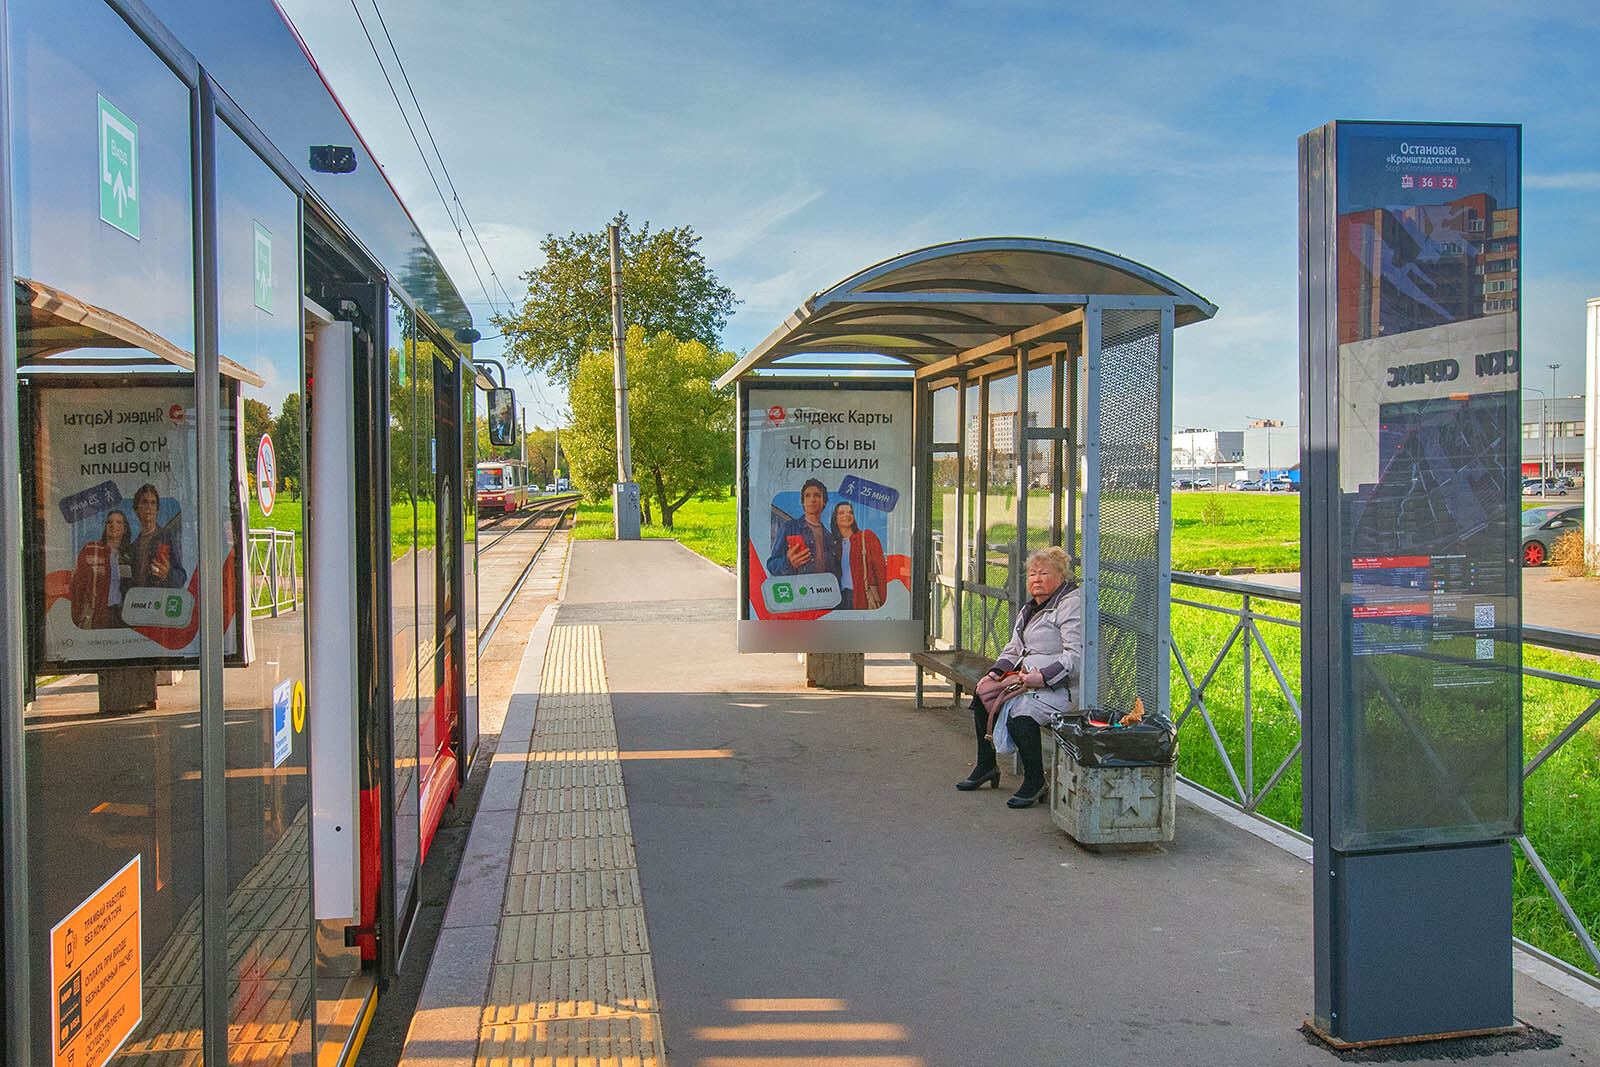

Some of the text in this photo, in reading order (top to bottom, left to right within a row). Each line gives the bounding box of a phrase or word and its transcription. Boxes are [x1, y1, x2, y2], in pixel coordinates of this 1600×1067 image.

[1400, 143, 1457, 155] Остановка
[1386, 154, 1453, 165] «Кронштадтская
[1421, 178, 1454, 188] 36 52
[793, 409, 893, 426] Яндекс Карты
[790, 435, 876, 451] Что бы вы
[786, 458, 879, 472] ни решили
[860, 486, 890, 502] 25 мин
[809, 586, 815, 595] 1
[84, 931, 93, 946] БЕЗ
